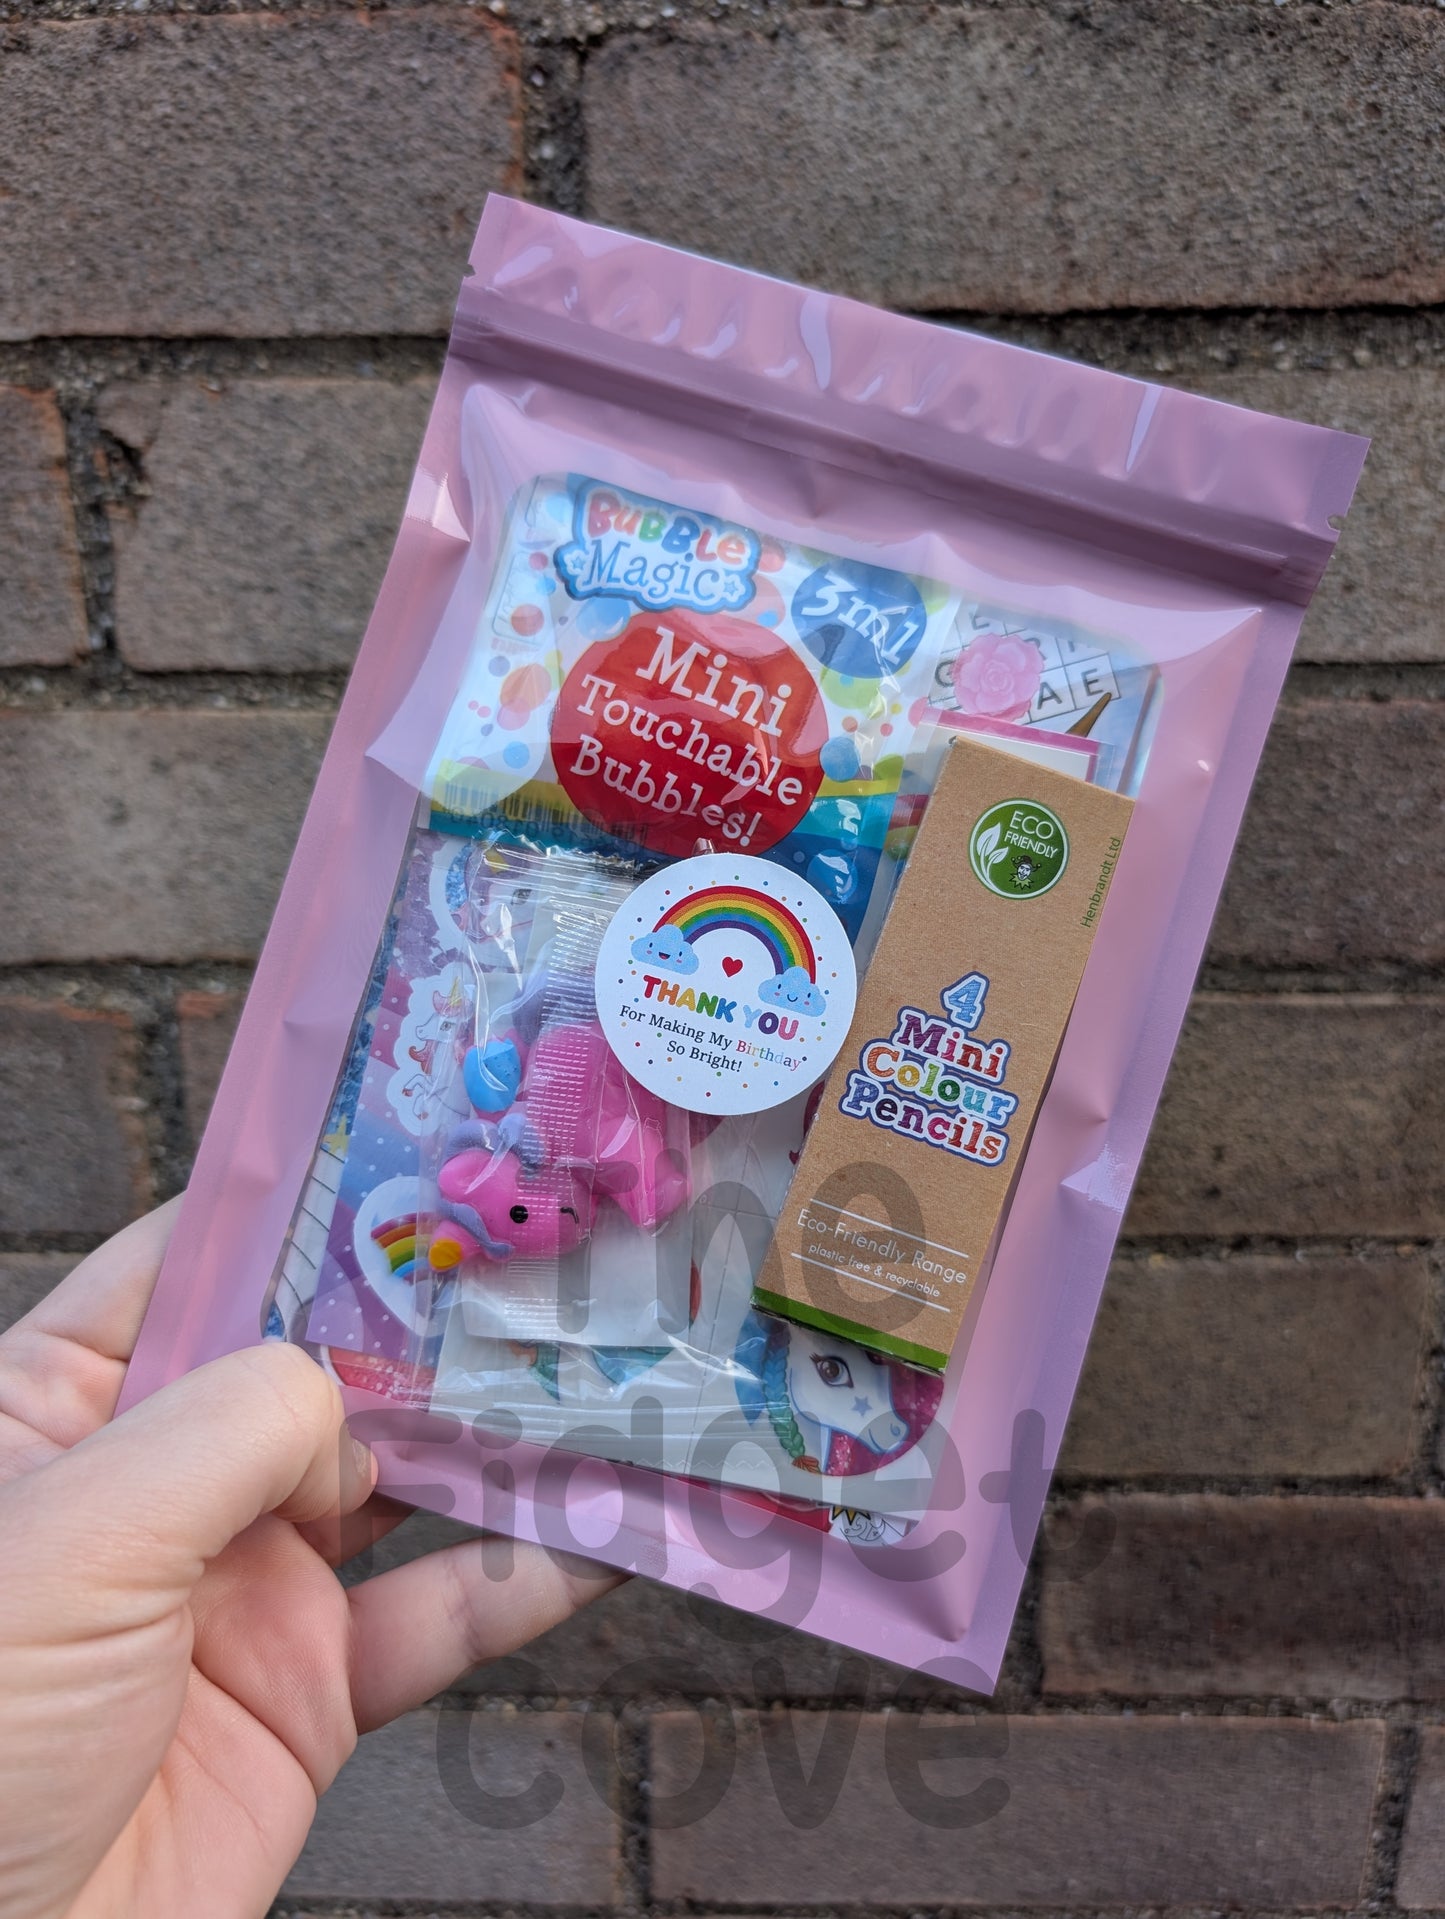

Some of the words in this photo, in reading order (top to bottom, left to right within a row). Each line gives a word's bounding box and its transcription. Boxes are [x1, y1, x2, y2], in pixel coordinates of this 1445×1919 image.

[582, 539, 721, 600] Magic
[801, 569, 919, 666] 3ml
[636, 626, 792, 738] Mini
[577, 674, 804, 806] Touchable
[570, 734, 763, 848] Bubbles!
[1009, 810, 1054, 839] ECO
[1004, 831, 1058, 858] FRIENDLY
[1079, 860, 1113, 928] Henbrandt
[1104, 837, 1121, 859] Ltd
[643, 974, 737, 1023] THANK
[742, 1004, 799, 1040] YOU
[947, 978, 985, 1024] 4
[619, 1004, 643, 1023] For
[648, 1013, 704, 1043] Making
[708, 1031, 733, 1051] My
[736, 1039, 802, 1072] Birthday
[666, 1040, 686, 1055] So
[689, 1047, 743, 1073] Bright!
[896, 1013, 1004, 1079] Mini
[867, 1045, 1011, 1122] Colour
[845, 1077, 1002, 1160] Pencils
[797, 1208, 905, 1265] Eco-Friendly
[911, 1250, 967, 1284] Range
[808, 1243, 845, 1264] plastic
[848, 1255, 871, 1273] free
[874, 1265, 883, 1278] &
[885, 1270, 941, 1298] recyclable
